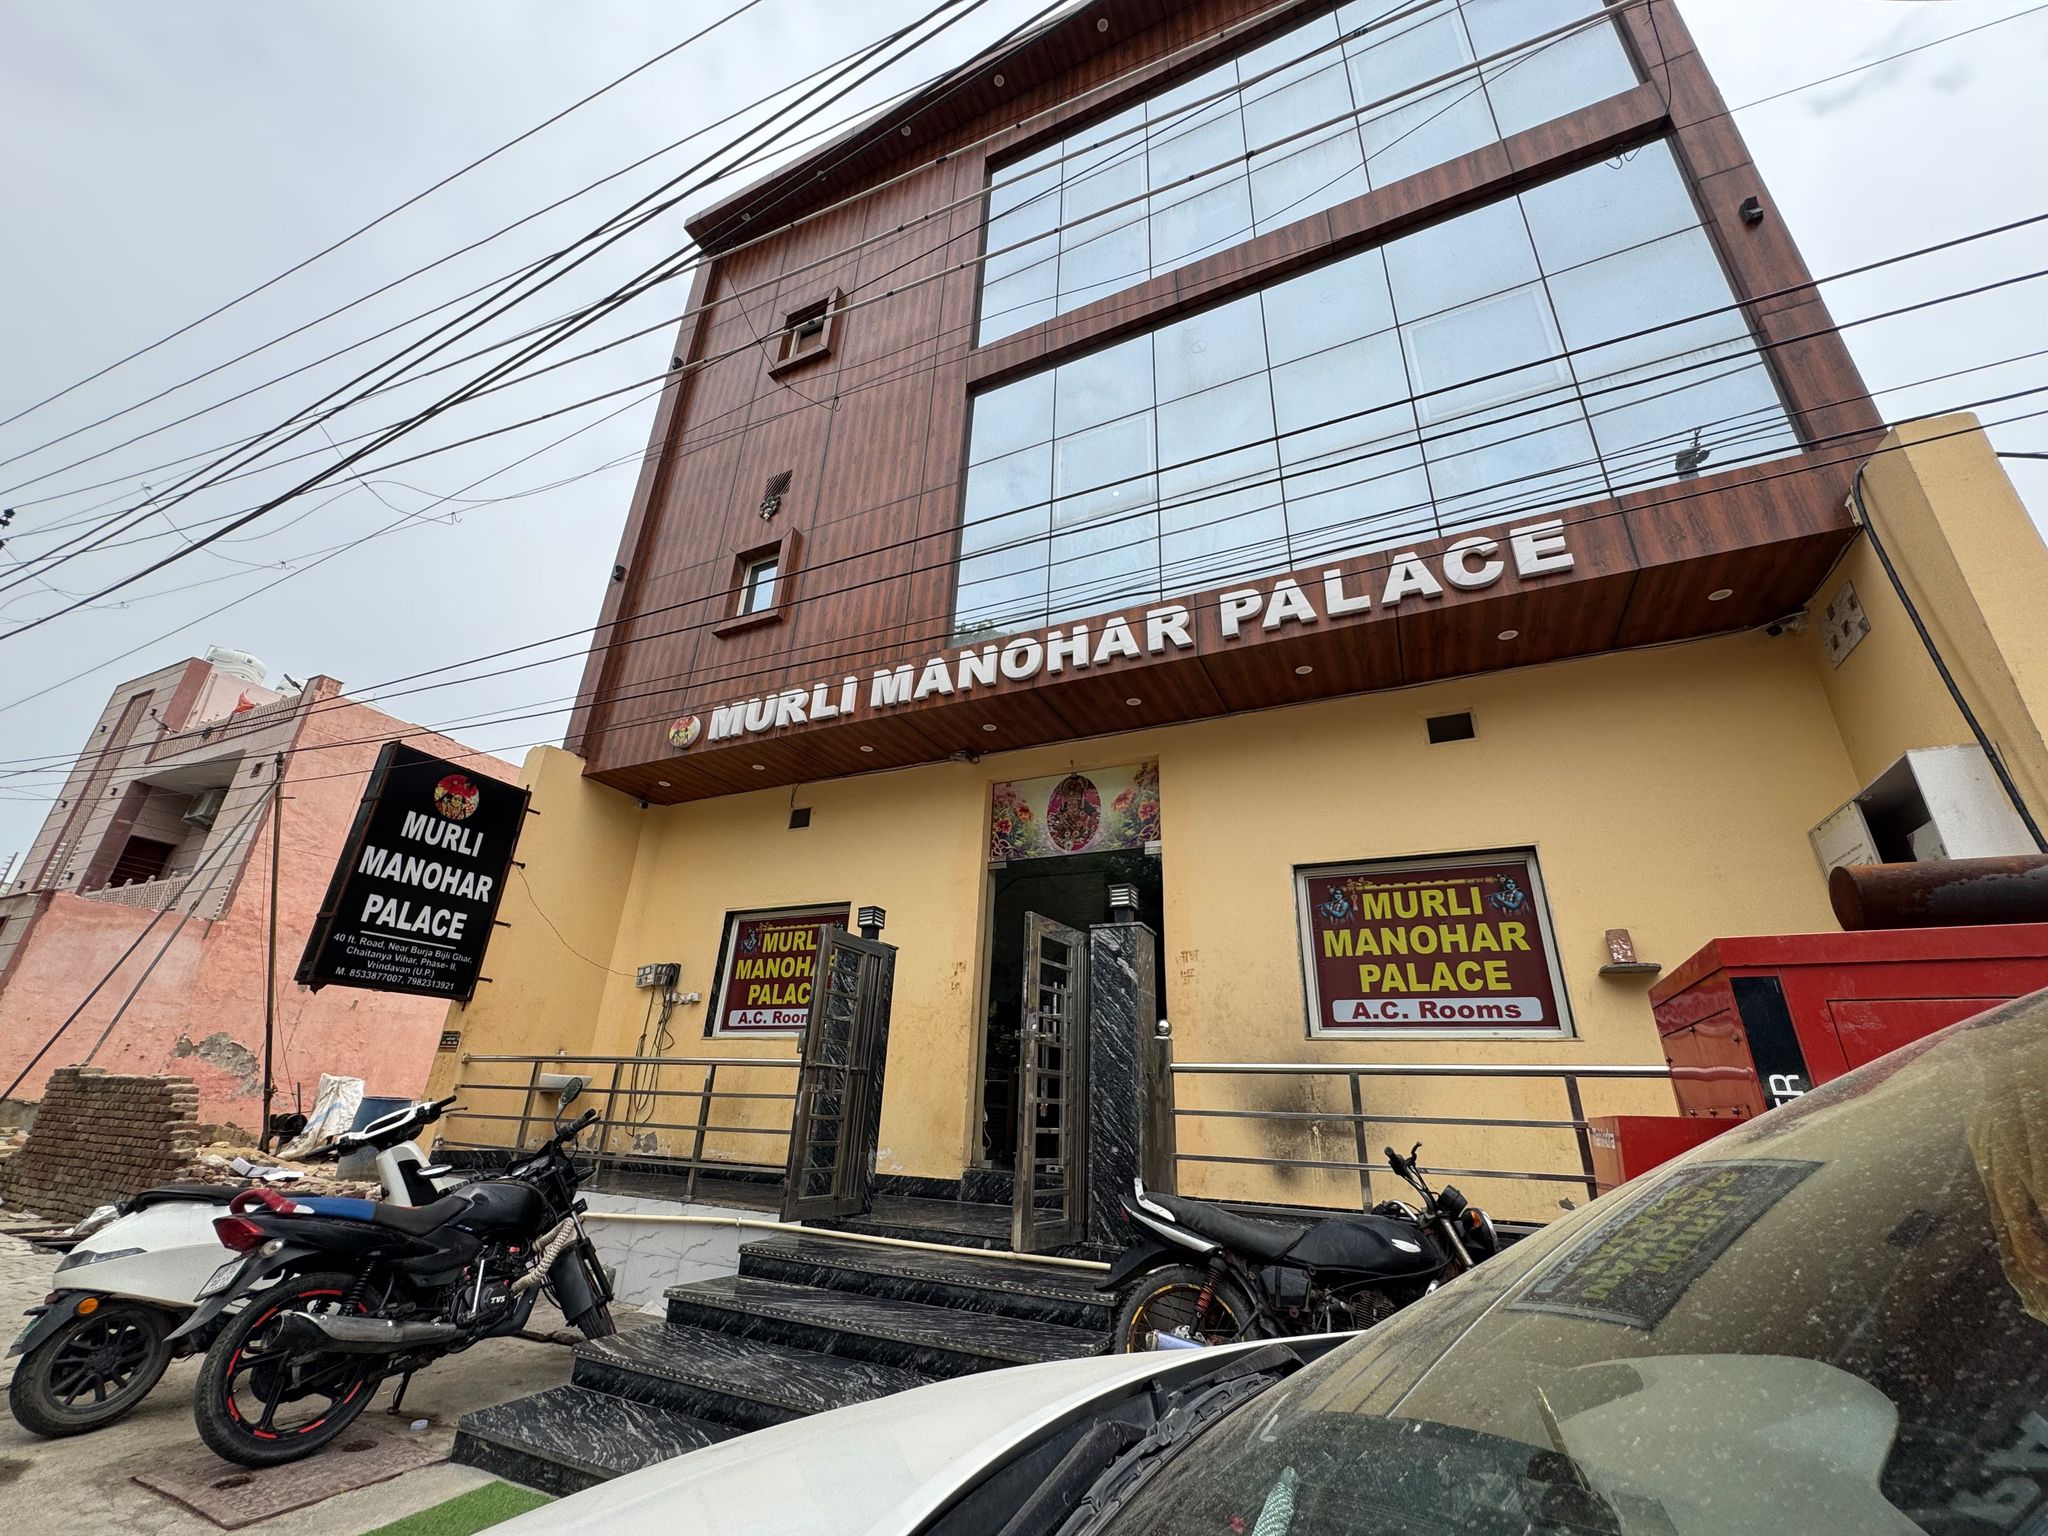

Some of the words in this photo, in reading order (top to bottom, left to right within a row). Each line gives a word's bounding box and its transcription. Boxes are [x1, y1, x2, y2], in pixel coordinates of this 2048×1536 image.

[707, 675, 859, 742] MURLI
[869, 605, 1195, 711] MANOHAR
[1219, 519, 1575, 639] PALACE
[401, 810, 484, 857] MURLI
[358, 846, 493, 902] MANOHAR
[361, 894, 468, 940] PALACE
[1362, 886, 1483, 921] MURLI
[333, 932, 346, 942] 40
[359, 937, 385, 950] Road,
[388, 942, 409, 953] Near
[410, 945, 434, 958] Burja
[435, 949, 451, 961] Bijli
[452, 953, 473, 965] Ghar,
[762, 931, 817, 952] MURL
[1322, 921, 1531, 958] MANOHAR
[346, 946, 393, 962] Chaitanya
[395, 953, 418, 966] Vihar,
[367, 960, 411, 974] Vrindavan
[412, 967, 435, 979] (U.P.)
[335, 966, 346, 976] M.
[407, 977, 455, 990] 7982313921
[1359, 960, 1512, 993] PALACE
[747, 983, 811, 1005] PALAC
[737, 1011, 767, 1025] A.C.
[772, 1010, 808, 1024] Roo
[1352, 1001, 1409, 1020] A.C.
[1418, 1000, 1522, 1020] Rooms
[490, 1295, 506, 1304] TVS
